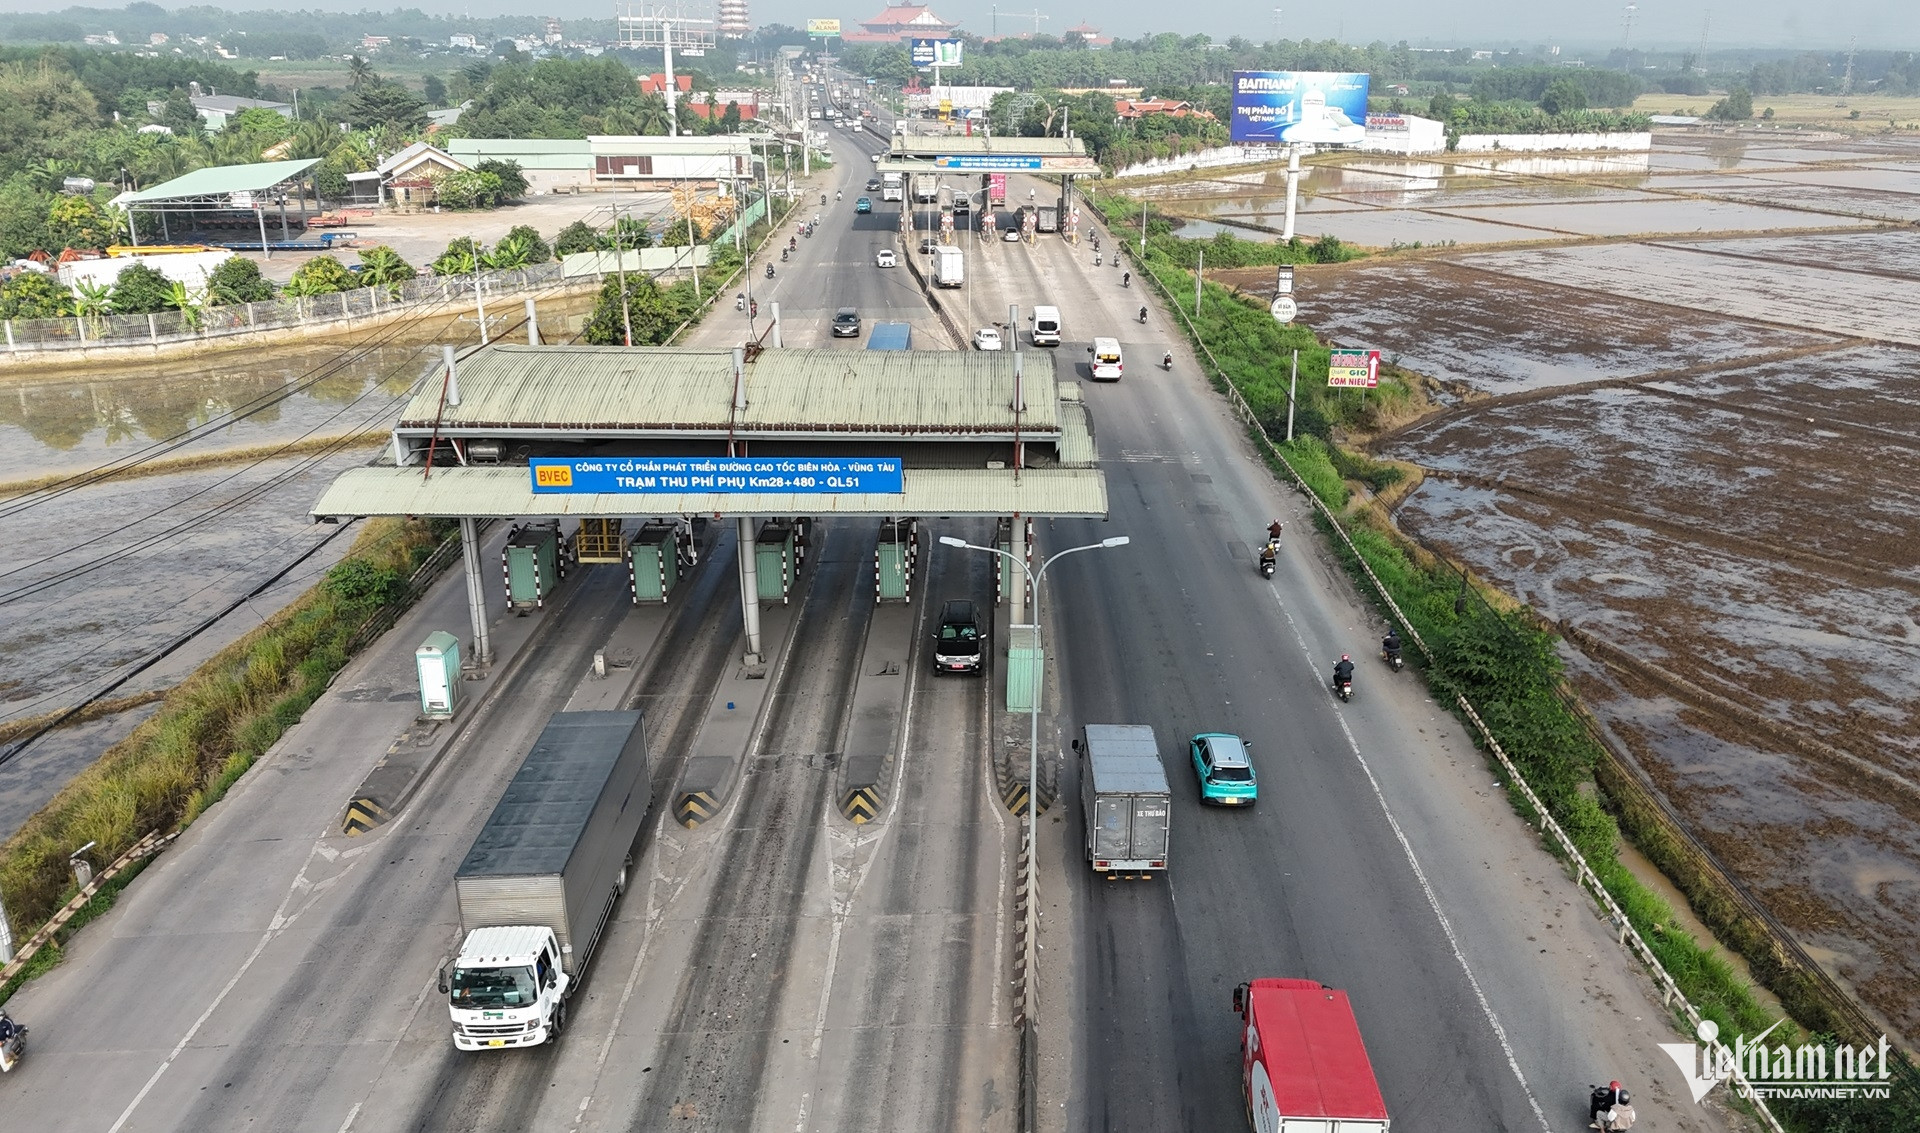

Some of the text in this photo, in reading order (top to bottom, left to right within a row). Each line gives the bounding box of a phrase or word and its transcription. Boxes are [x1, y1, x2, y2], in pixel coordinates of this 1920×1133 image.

[539, 470, 569, 483] BVEC
[575, 461, 603, 472] CÔNG
[605, 463, 617, 472] TY
[620, 459, 634, 472] CỔ
[663, 461, 687, 472] PHÁT
[690, 459, 717, 472] TRIỂN
[718, 461, 752, 472] ĐƯỜNG
[754, 463, 774, 472] CAO
[777, 461, 796, 472] TỐC
[798, 462, 818, 472] BIÊN
[821, 462, 840, 472] HÒA
[848, 462, 873, 472] VÙNG
[877, 462, 895, 472] TÀU
[616, 476, 656, 489] TRẠM
[659, 476, 688, 488] THU
[691, 474, 714, 488] PHÍ
[717, 476, 745, 489] PHỤ
[750, 476, 815, 488] Km28+480
[826, 476, 860, 488] QL51
